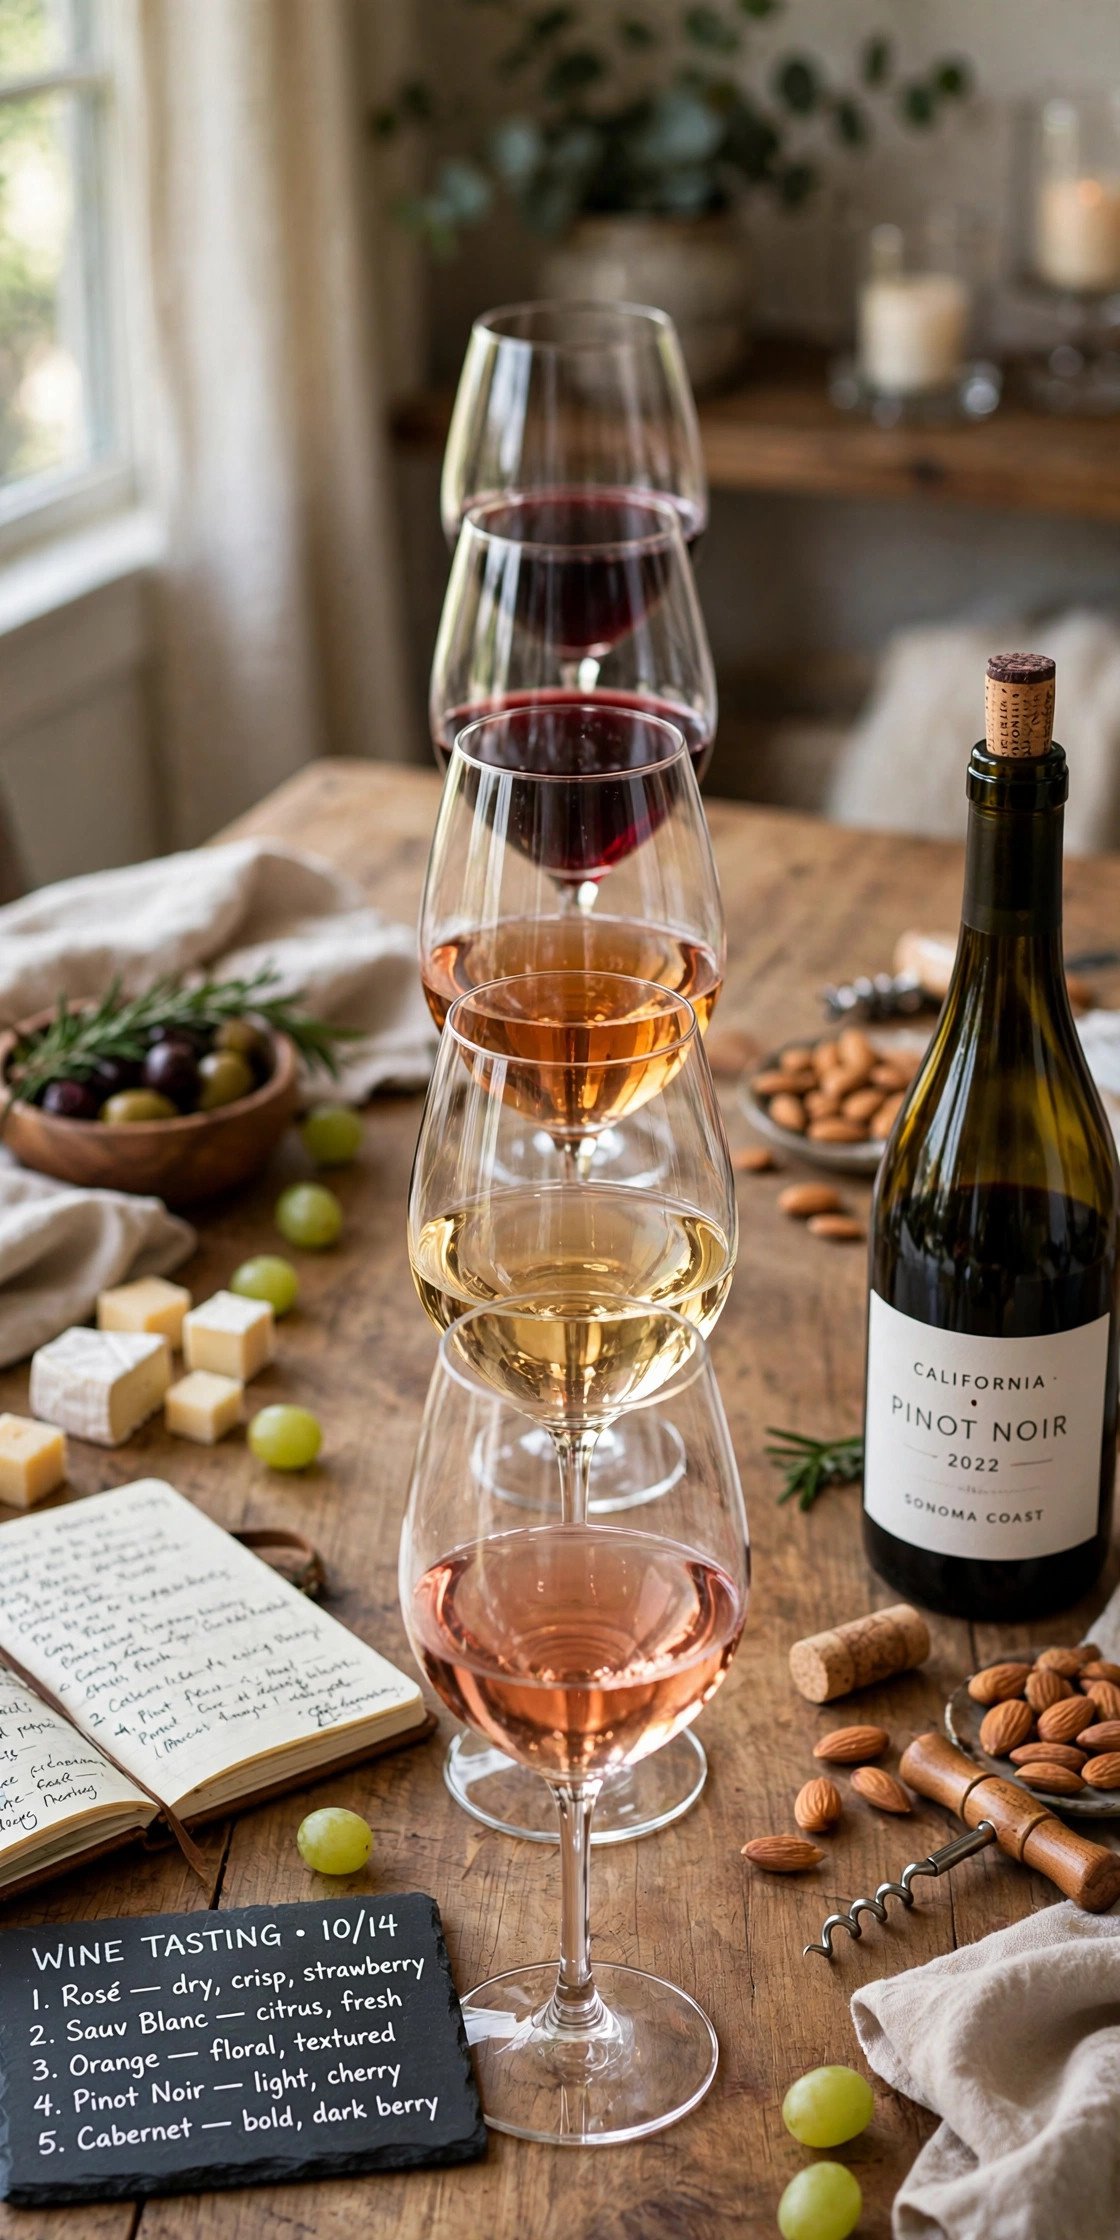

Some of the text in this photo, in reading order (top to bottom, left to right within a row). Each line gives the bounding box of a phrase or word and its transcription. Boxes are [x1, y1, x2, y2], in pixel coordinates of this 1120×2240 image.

[913, 1362, 1045, 1390] CALIFORNIA
[892, 1395, 1067, 1443] PINOT NOIR
[948, 1453, 1000, 1473] 2022
[904, 1493, 1044, 1524] SONOMA COAST
[31, 1939, 125, 1970] WINE
[140, 1923, 281, 1958] TASTING
[322, 1910, 398, 1944] 10/14
[32, 1988, 50, 2011] 1.
[61, 1980, 122, 2008] Rosé
[172, 1973, 221, 2002] dry,
[231, 1968, 294, 1994] crisp,
[303, 1955, 425, 1981] strawberry
[29, 2024, 55, 2047] 2.
[66, 2018, 127, 2042] Sauv
[139, 2010, 209, 2035] Blanc
[256, 1999, 332, 2021] citrus,
[340, 1987, 403, 2012] fresh
[32, 2058, 58, 2081] 3.
[69, 2053, 160, 2079] Orange
[209, 2035, 285, 2062] floral,
[293, 2021, 397, 2052] textured
[33, 2093, 61, 2117] 4.
[73, 2086, 139, 2113] Pinot
[151, 2080, 205, 2104] Noir
[254, 2067, 317, 2100] light,
[327, 2062, 401, 2088] cherry
[38, 2130, 65, 2156] 5.
[77, 2116, 193, 2151] Cabernet
[242, 2105, 303, 2132] bold,
[312, 2098, 368, 2124] dark
[375, 2095, 439, 2122] berry
